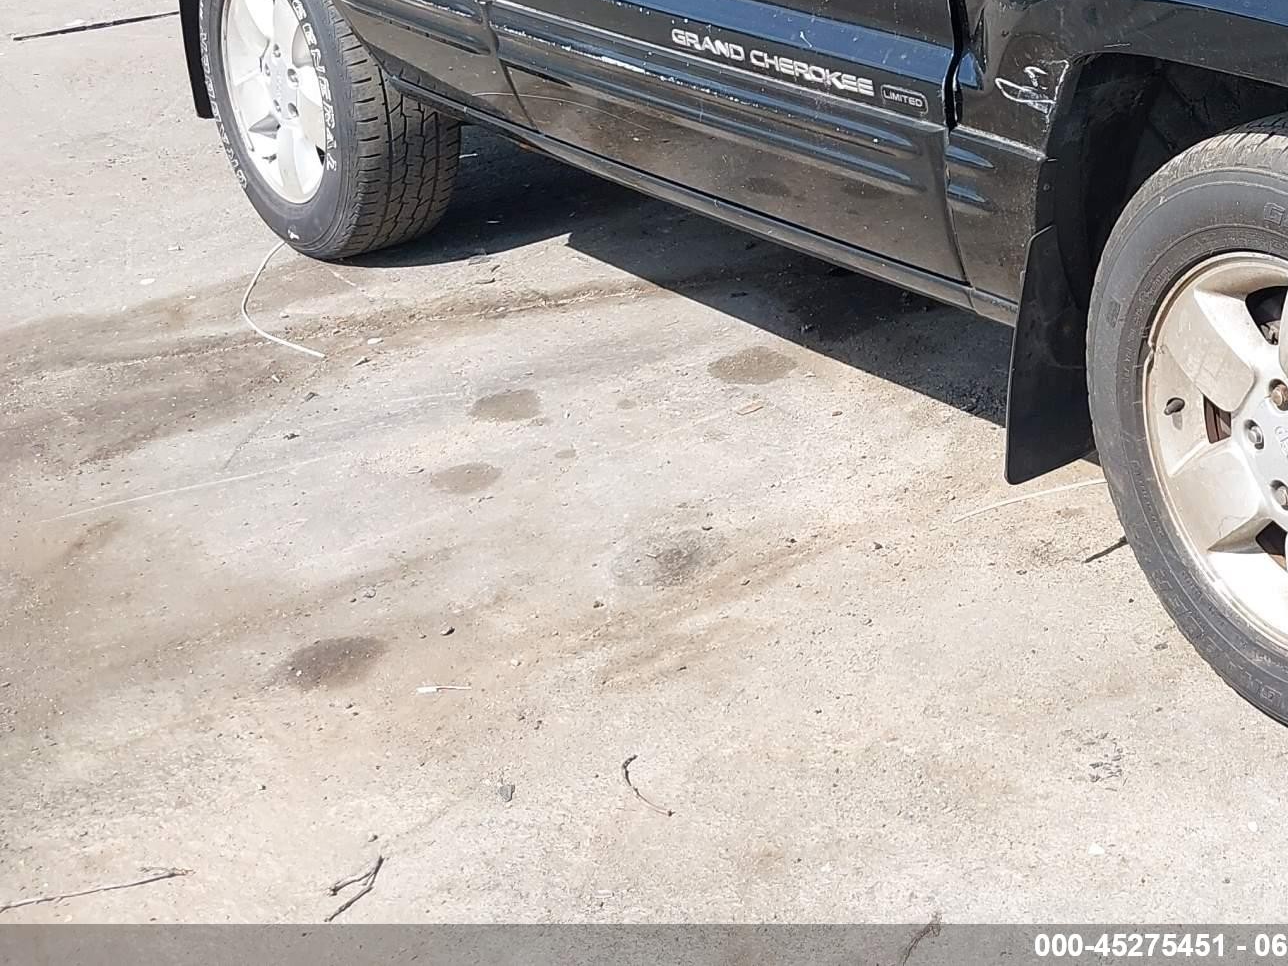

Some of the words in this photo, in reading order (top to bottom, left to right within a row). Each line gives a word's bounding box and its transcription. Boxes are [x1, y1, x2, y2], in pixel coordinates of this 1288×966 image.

[671, 28, 745, 61] GRAND
[750, 49, 875, 97] CHEROKEE
[883, 89, 924, 109] LIMITED
